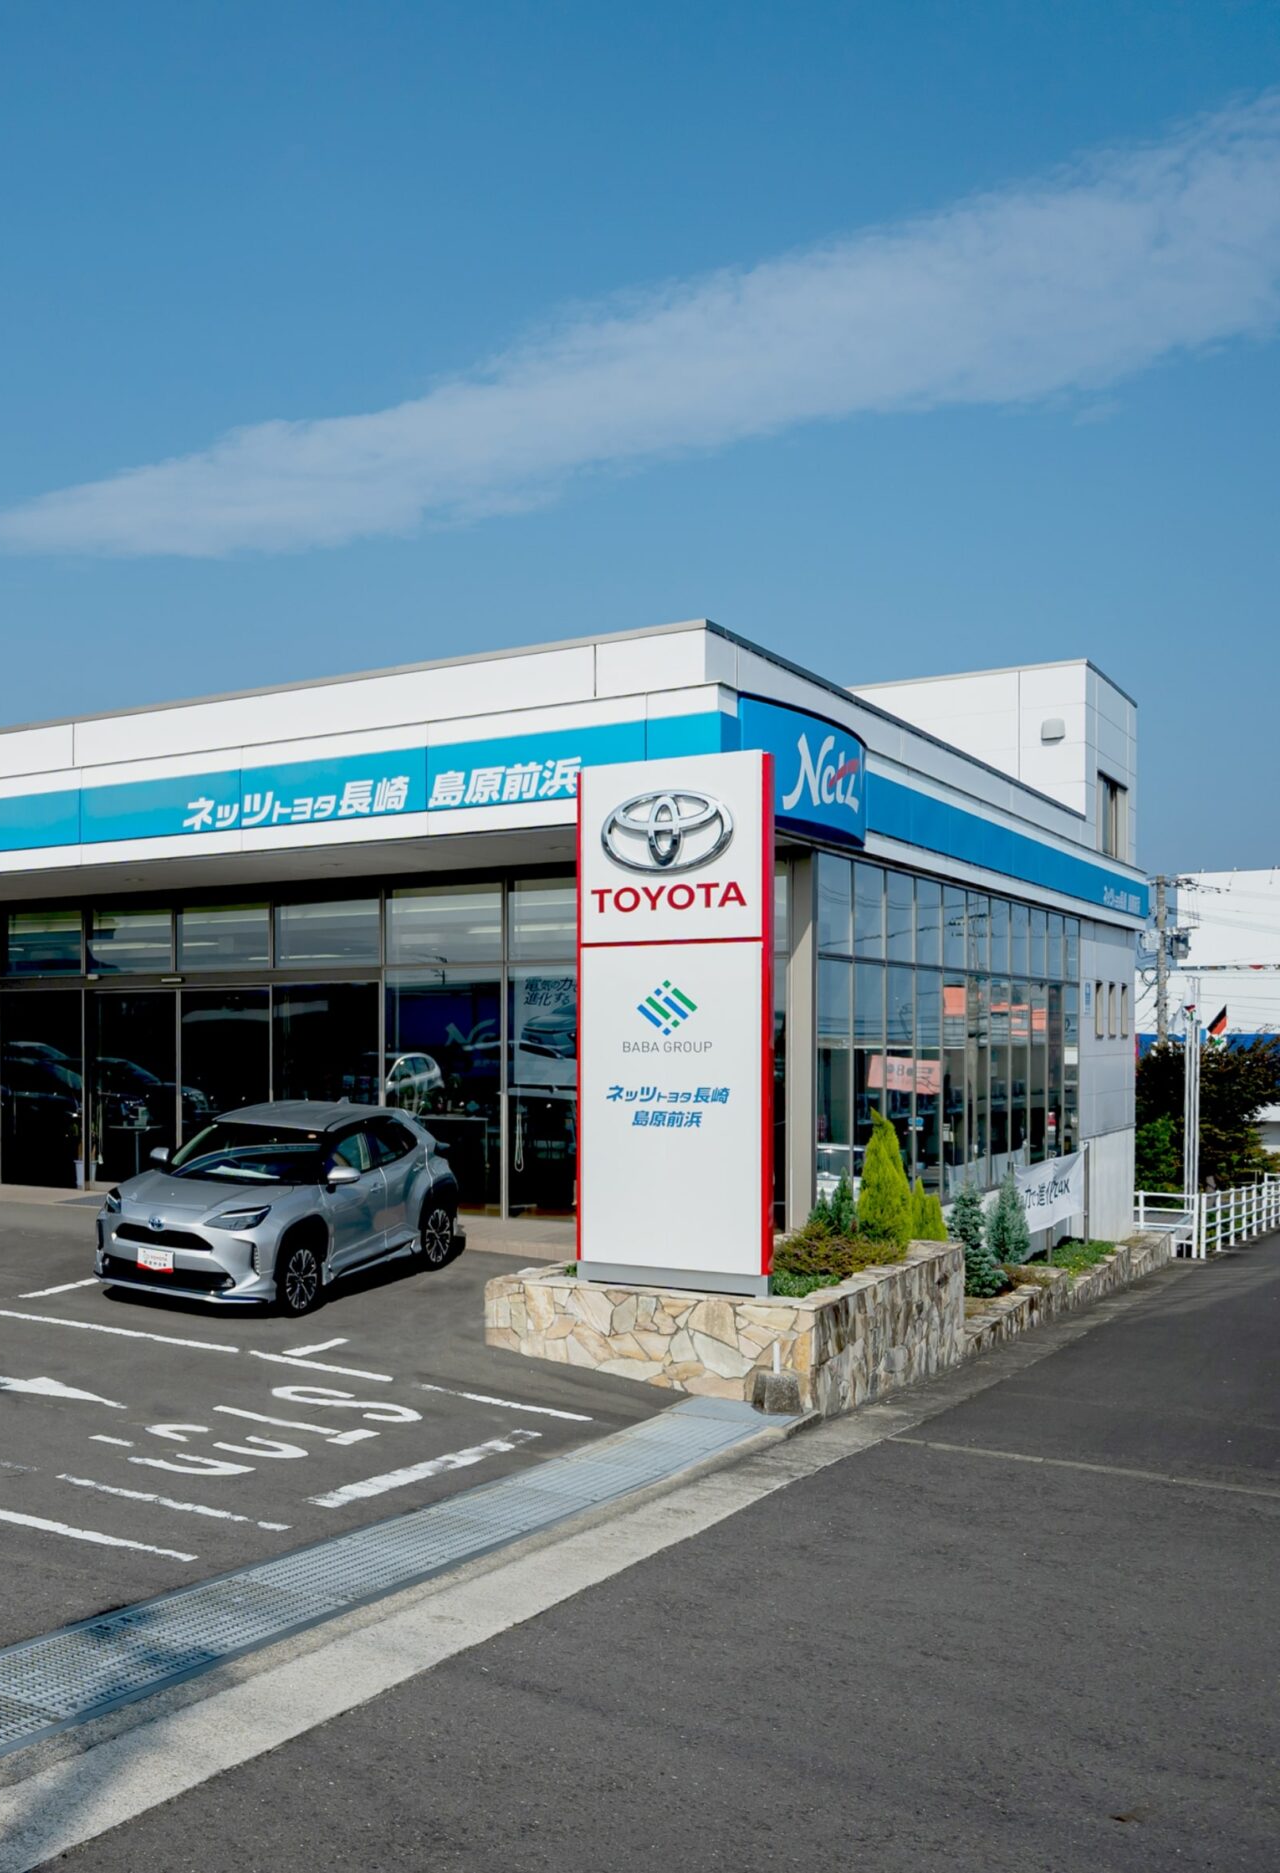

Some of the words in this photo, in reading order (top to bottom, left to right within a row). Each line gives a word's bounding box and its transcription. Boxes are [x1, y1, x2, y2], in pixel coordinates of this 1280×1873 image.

[782, 732, 860, 815] Netz
[182, 775, 410, 831] ネッツトヨタ長崎
[429, 756, 582, 806] 島原前浜
[591, 881, 747, 913] TOYOTA
[622, 1041, 659, 1053] BABA
[663, 1041, 713, 1053] GROUP
[606, 1085, 730, 1104] ネッツトヨタ長崎
[631, 1110, 702, 1128] 島原前浜
